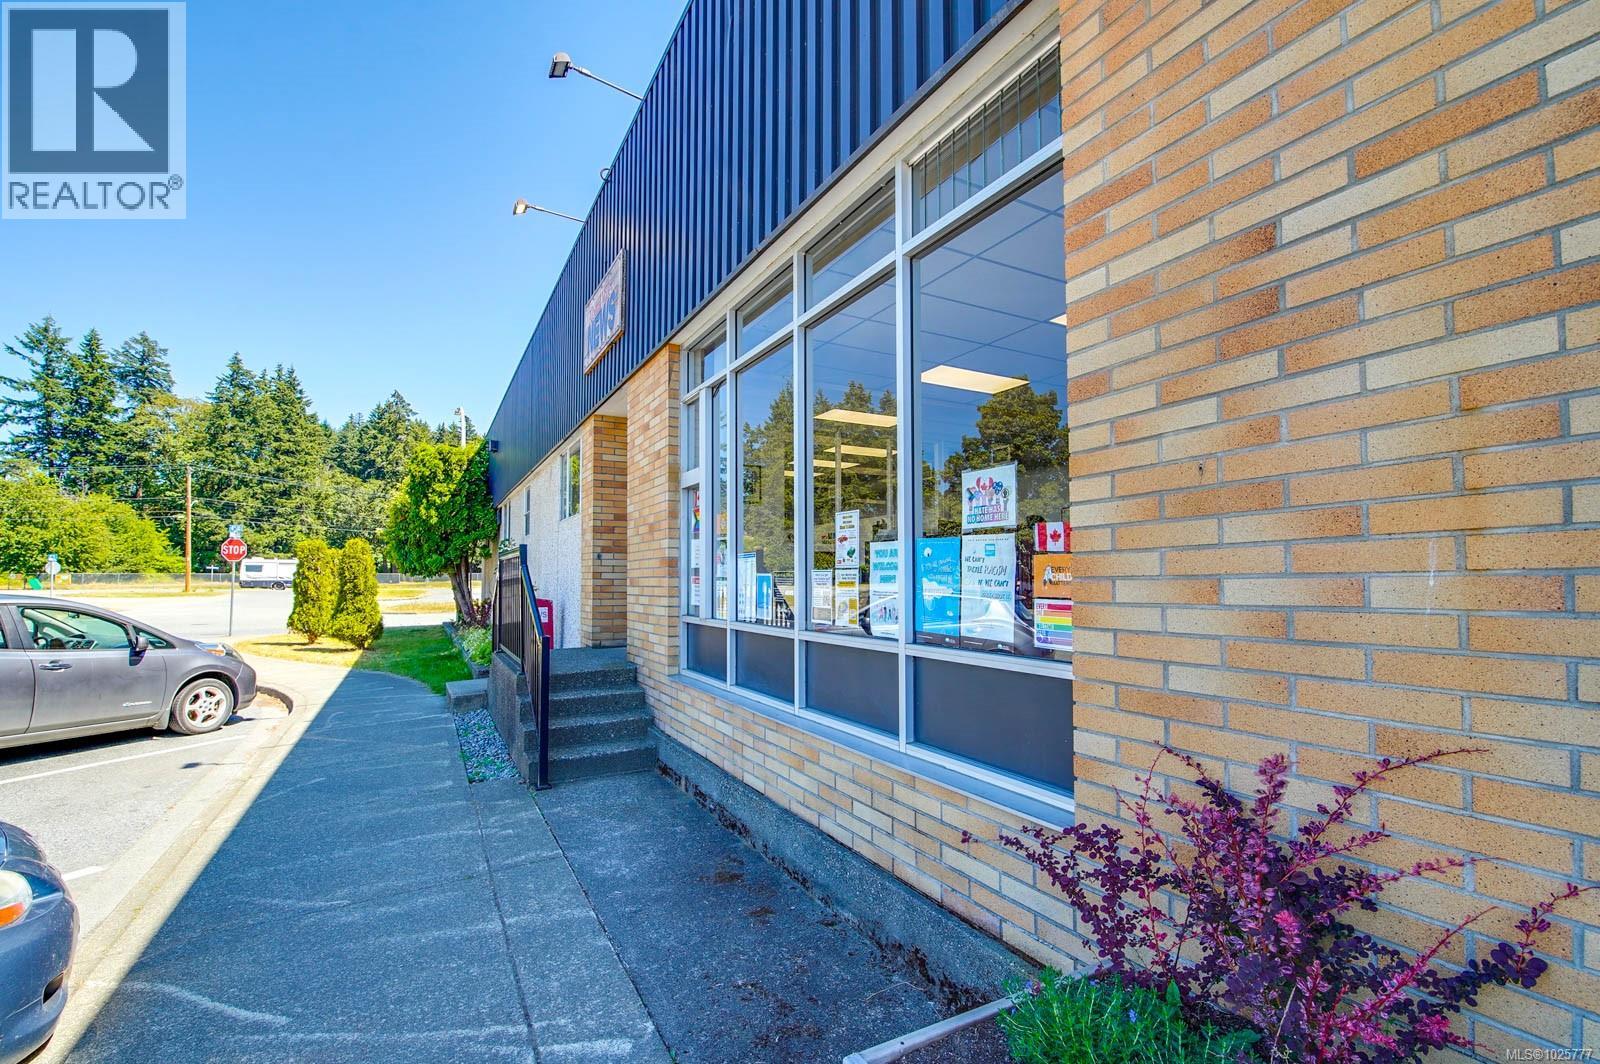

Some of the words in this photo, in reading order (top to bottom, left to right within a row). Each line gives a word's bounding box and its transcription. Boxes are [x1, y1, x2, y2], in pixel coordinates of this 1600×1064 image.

[588, 290, 617, 352] NEWS
[974, 504, 988, 514] HATE
[967, 515, 976, 524] NO
[976, 514, 993, 522] HOME
[994, 512, 1009, 520] HERE
[223, 545, 245, 554] STOP
[874, 549, 888, 558] YOU
[1052, 573, 1073, 581] CHILD
